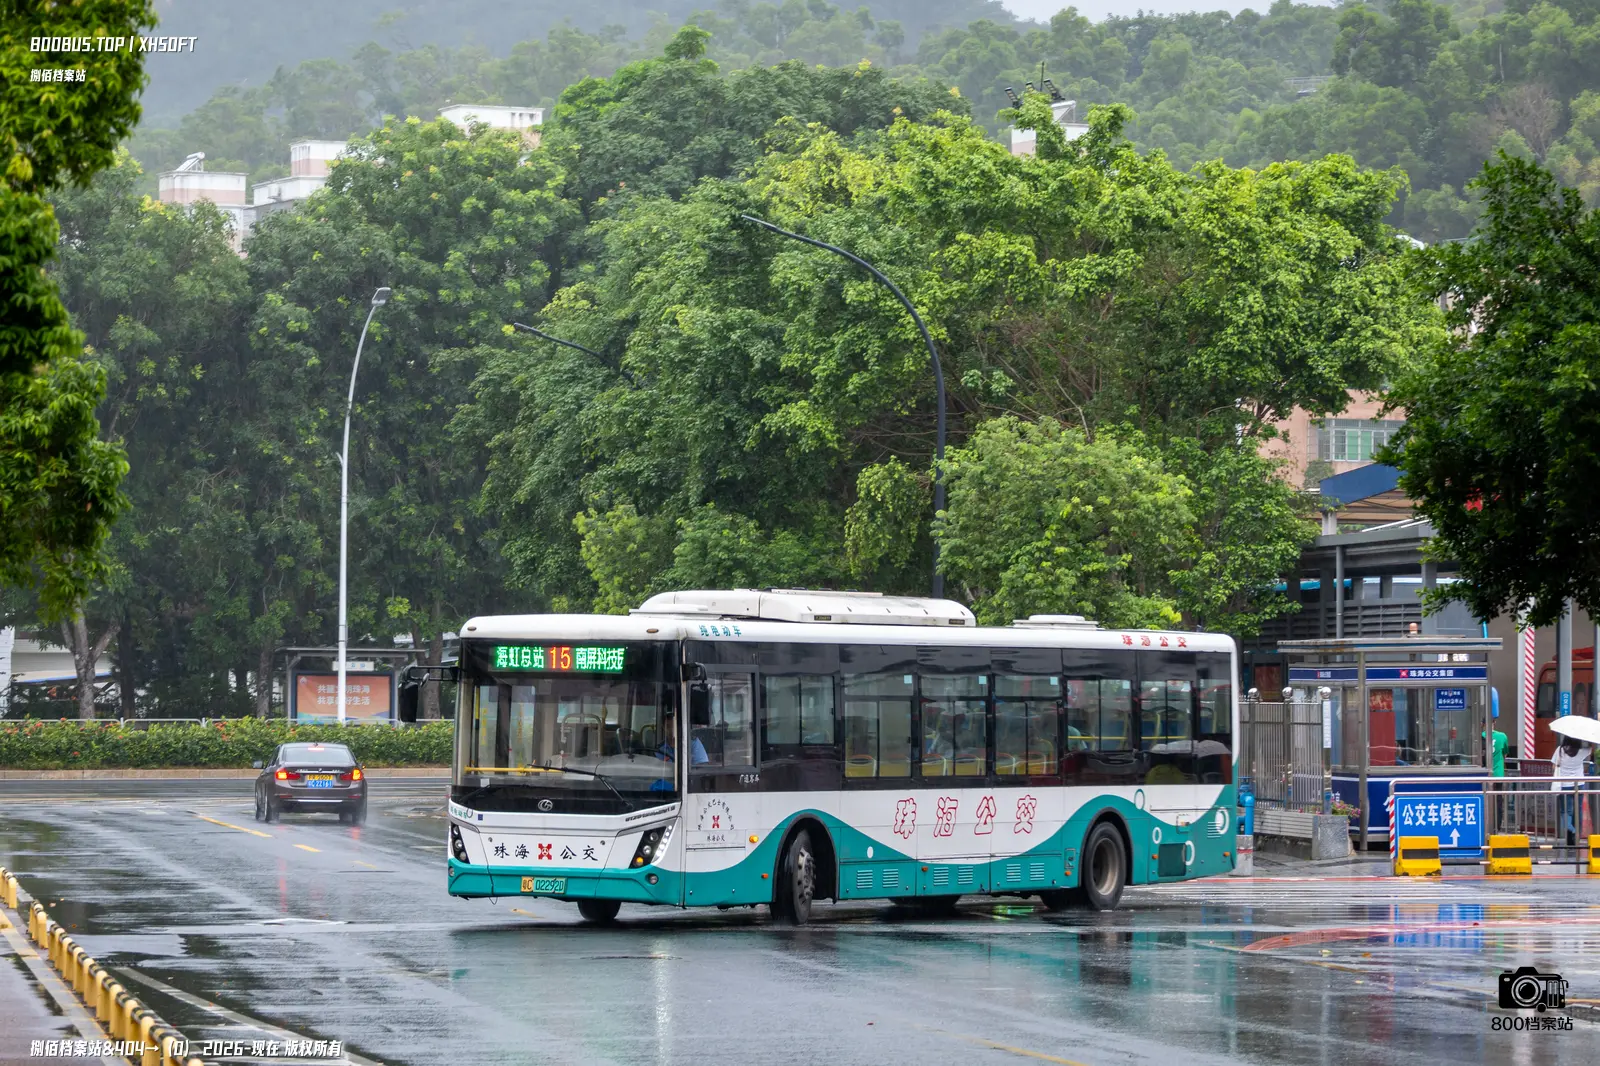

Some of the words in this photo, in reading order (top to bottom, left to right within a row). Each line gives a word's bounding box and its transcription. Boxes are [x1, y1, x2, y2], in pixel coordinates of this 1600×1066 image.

[699, 624, 742, 637] 纯电动车
[1121, 634, 1187, 648] 珠海公交
[496, 646, 545, 669] 海虹总站
[549, 646, 571, 669] 15
[1409, 669, 1454, 678] 珠海公交集团
[317, 696, 371, 705] 共享好生活
[894, 794, 1037, 839] 珠海公交
[1402, 802, 1477, 827] 公交车候车区
[494, 842, 530, 859] 珠海
[560, 845, 599, 861] 公交
